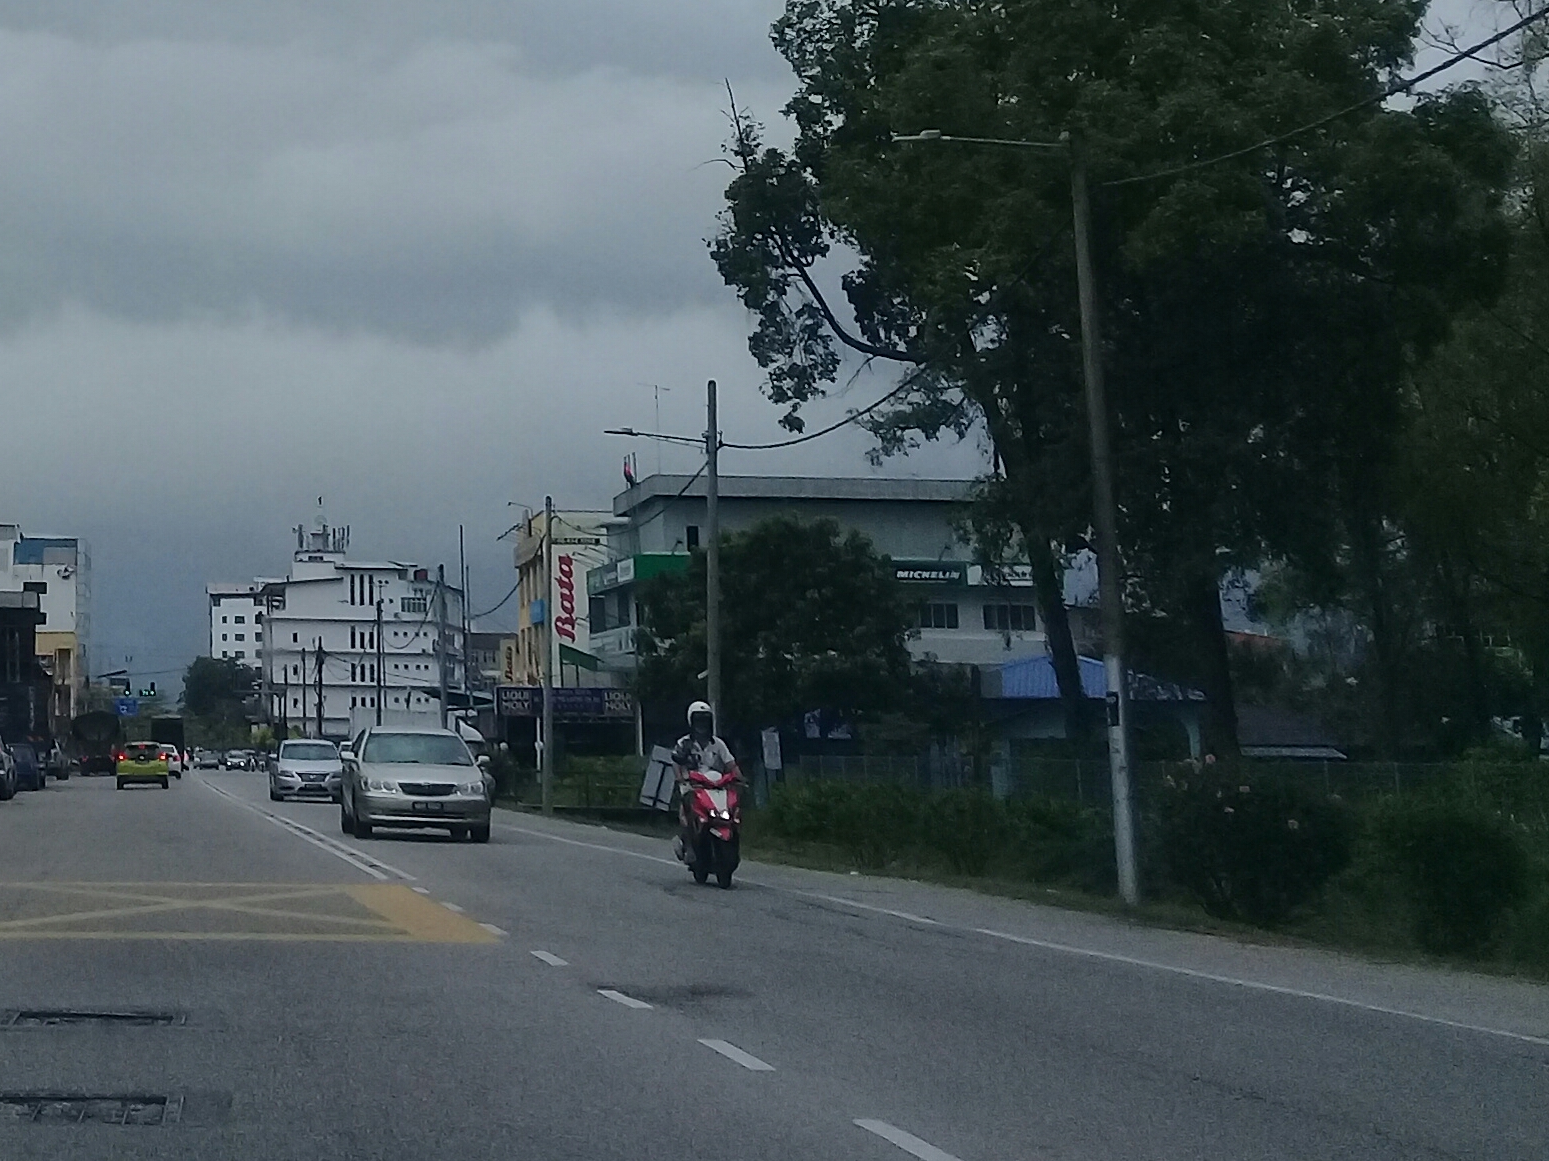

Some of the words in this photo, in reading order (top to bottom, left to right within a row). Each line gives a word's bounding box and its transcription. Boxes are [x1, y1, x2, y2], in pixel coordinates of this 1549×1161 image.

[896, 569, 961, 580] MICHELIN
[554, 553, 575, 643] Bata
[502, 701, 531, 711] MOLY
